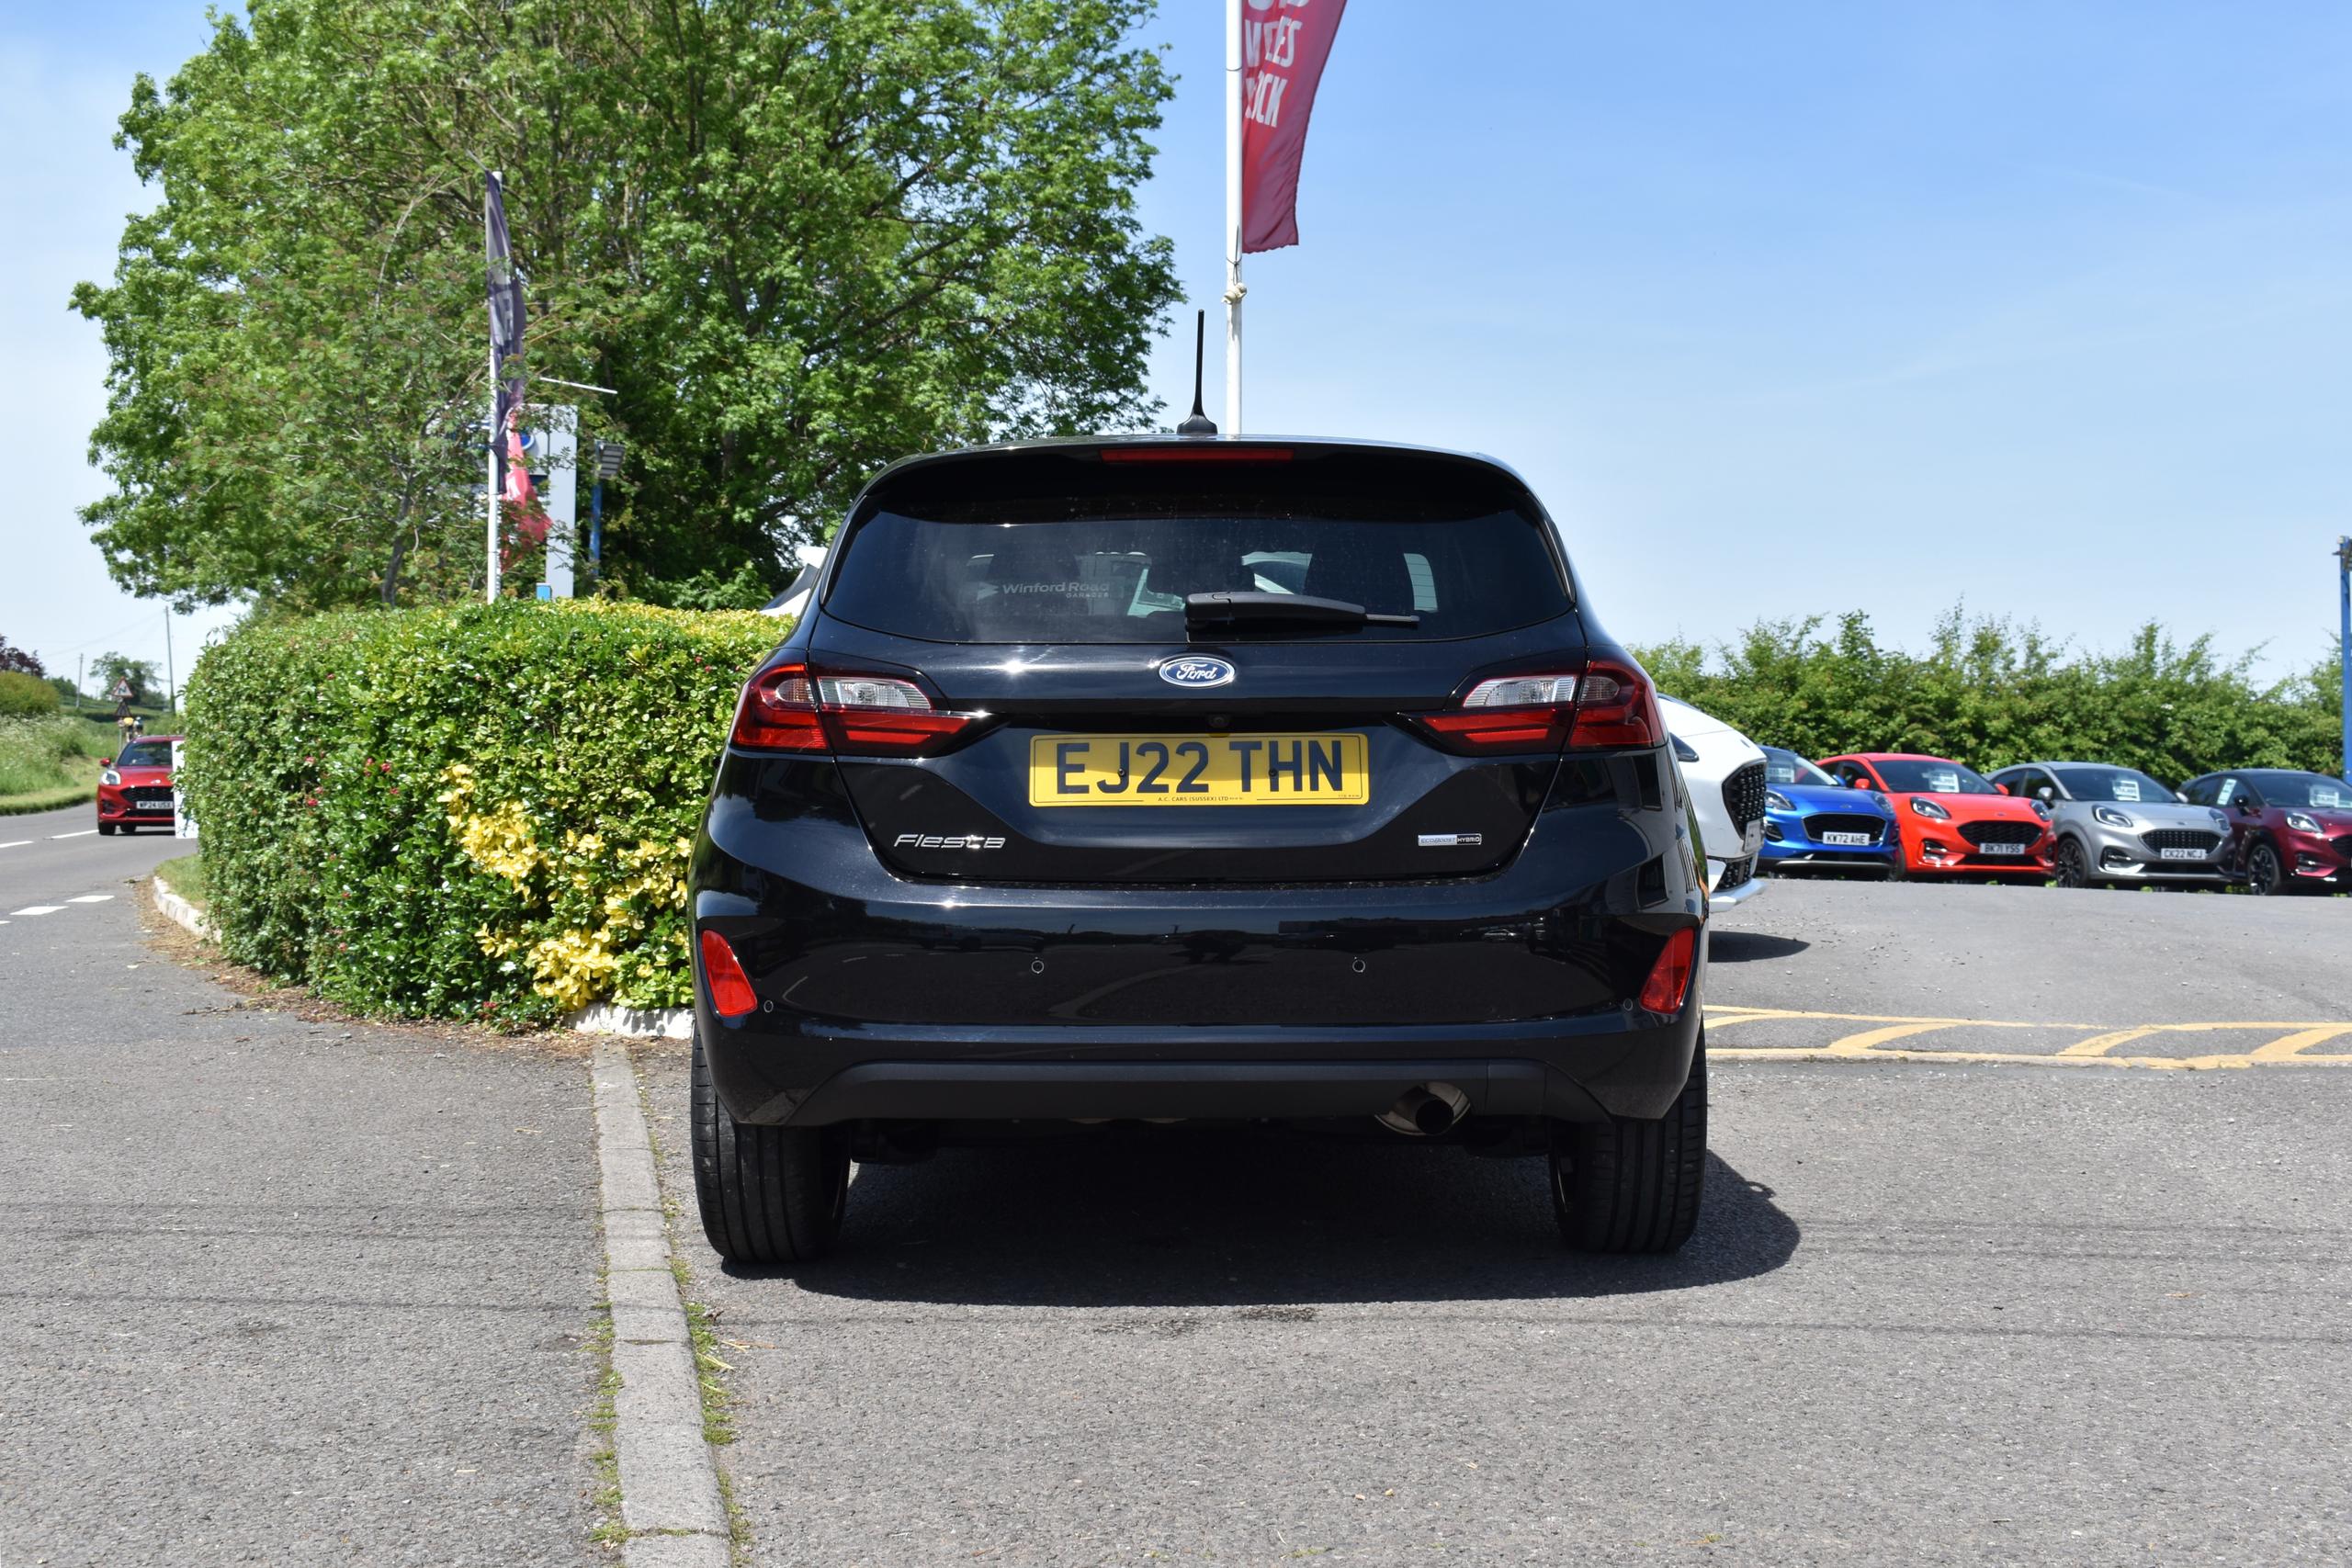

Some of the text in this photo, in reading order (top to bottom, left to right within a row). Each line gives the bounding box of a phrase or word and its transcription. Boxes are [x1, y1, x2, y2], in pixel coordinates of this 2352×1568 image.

[1002, 581, 1110, 594] Winford Road
[1176, 662, 1218, 680] Ford
[1056, 740, 1343, 795] EJ22 THN
